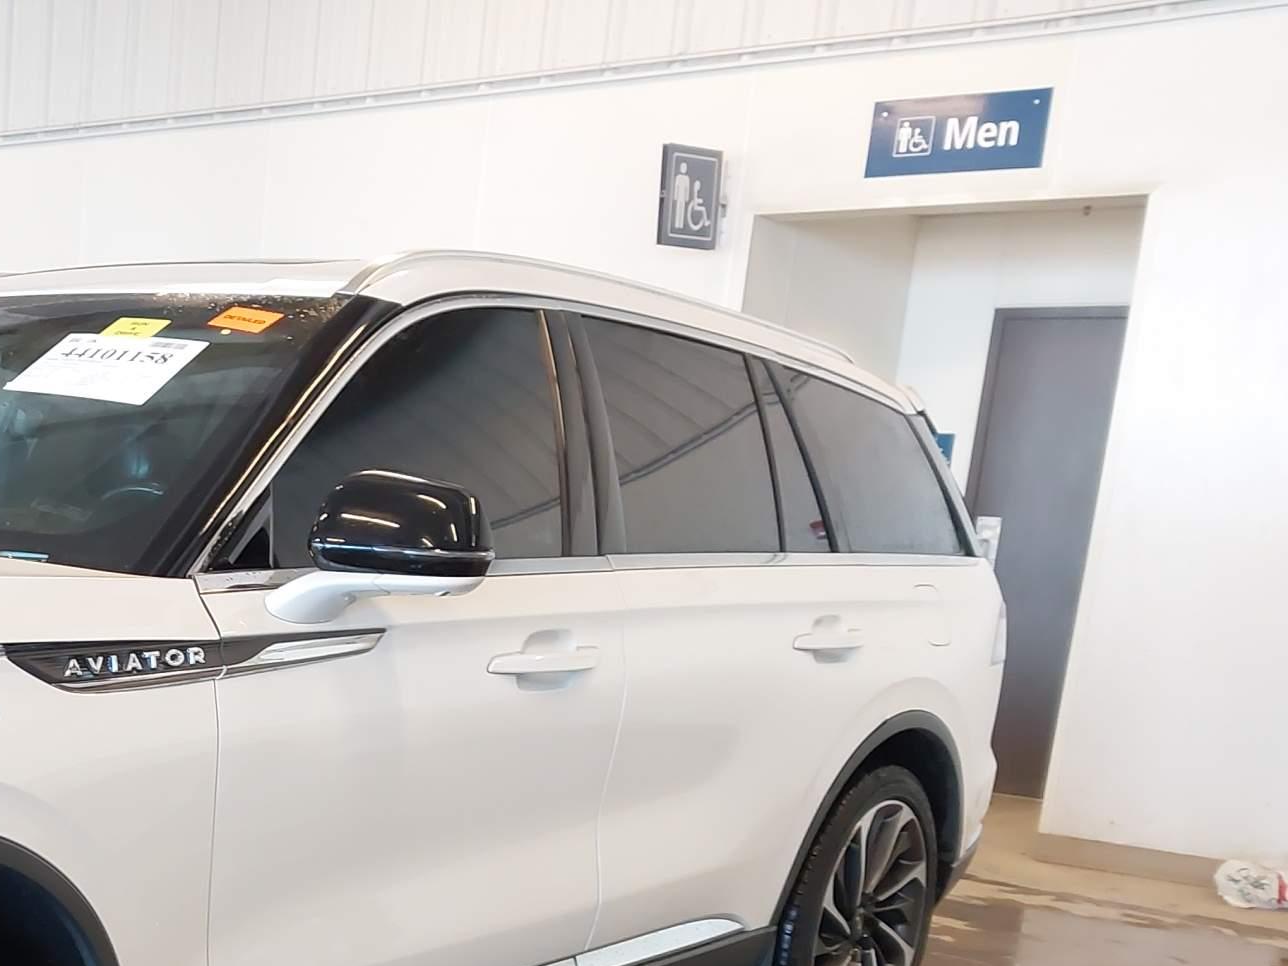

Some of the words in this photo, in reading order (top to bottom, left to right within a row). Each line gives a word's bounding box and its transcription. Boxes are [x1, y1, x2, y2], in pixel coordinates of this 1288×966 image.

[942, 115, 1021, 151] Men
[223, 314, 267, 325] DETAILED
[60, 347, 174, 365] 44101158
[63, 646, 207, 678] AVIATOR
